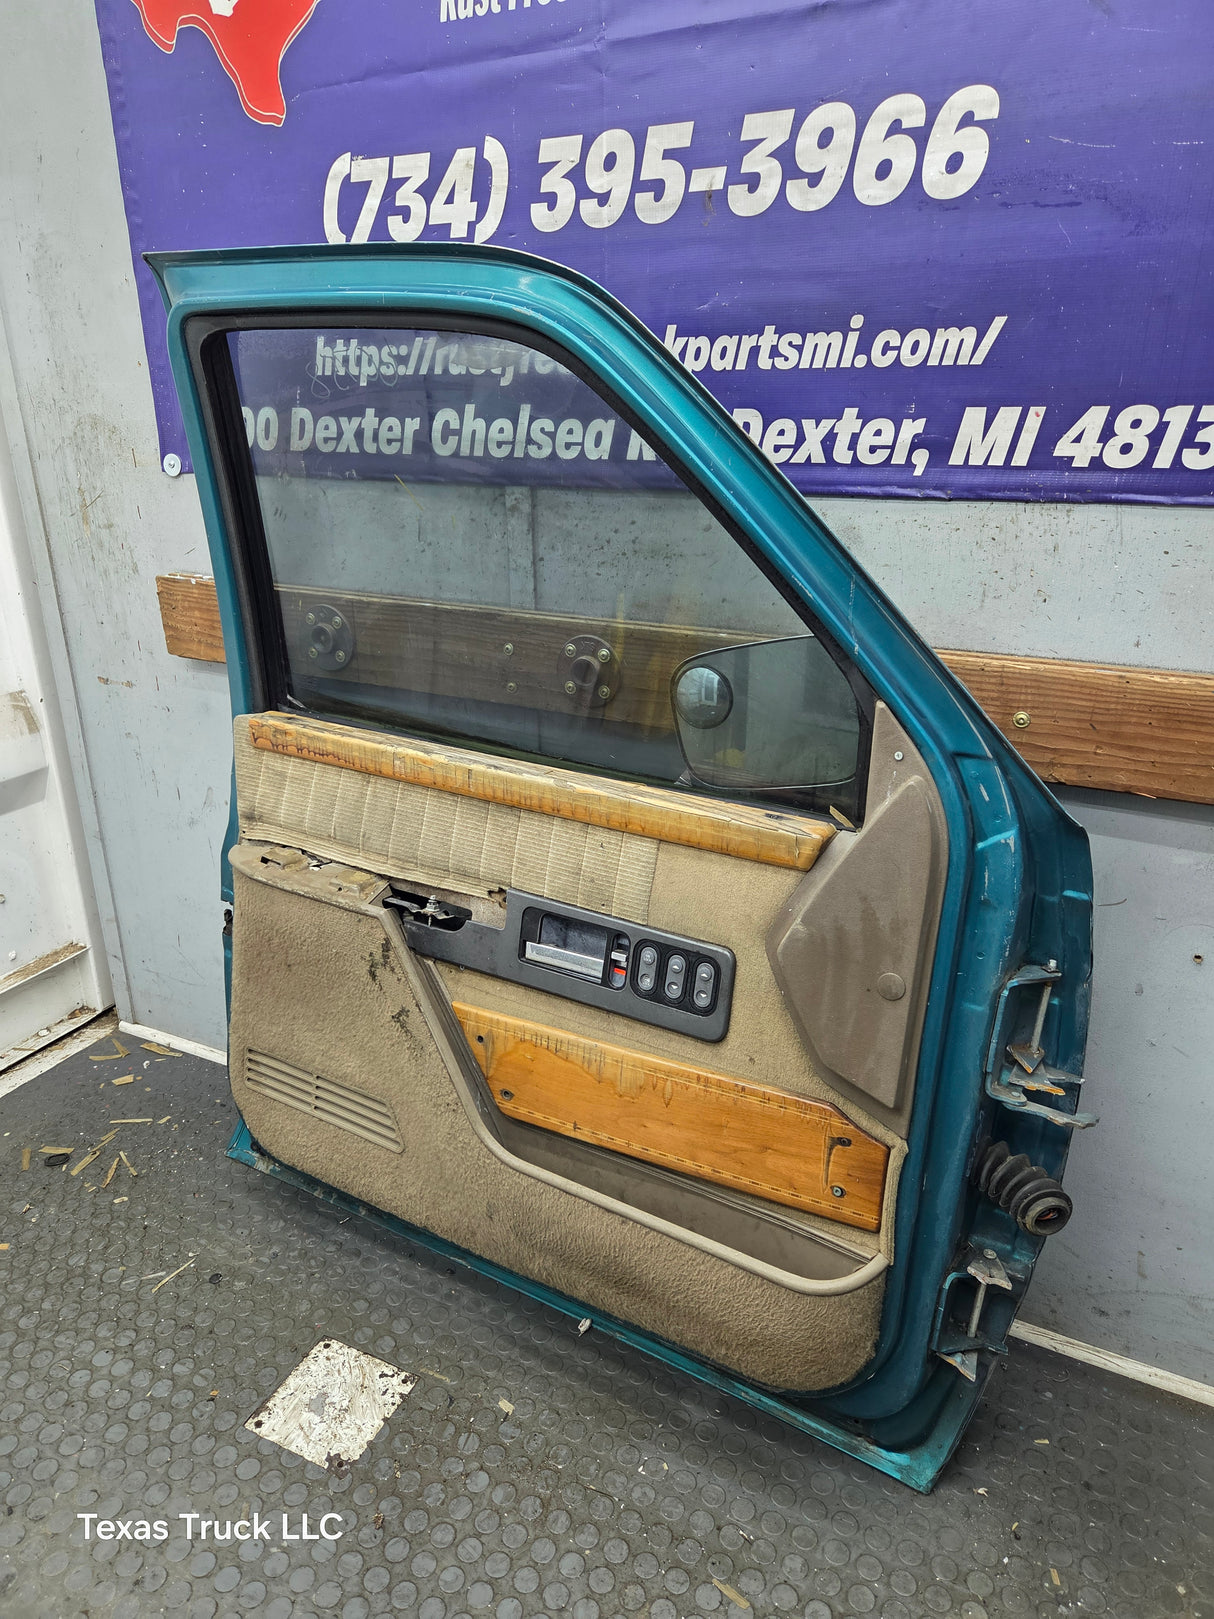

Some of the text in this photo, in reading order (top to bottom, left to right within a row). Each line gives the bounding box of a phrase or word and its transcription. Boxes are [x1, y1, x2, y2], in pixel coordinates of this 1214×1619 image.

[323, 84, 1000, 244] (734) 395-3966
[290, 407, 420, 455] Dexter
[431, 403, 616, 461] Chelsea
[732, 407, 929, 476] Dexter,
[948, 406, 1046, 467] MI
